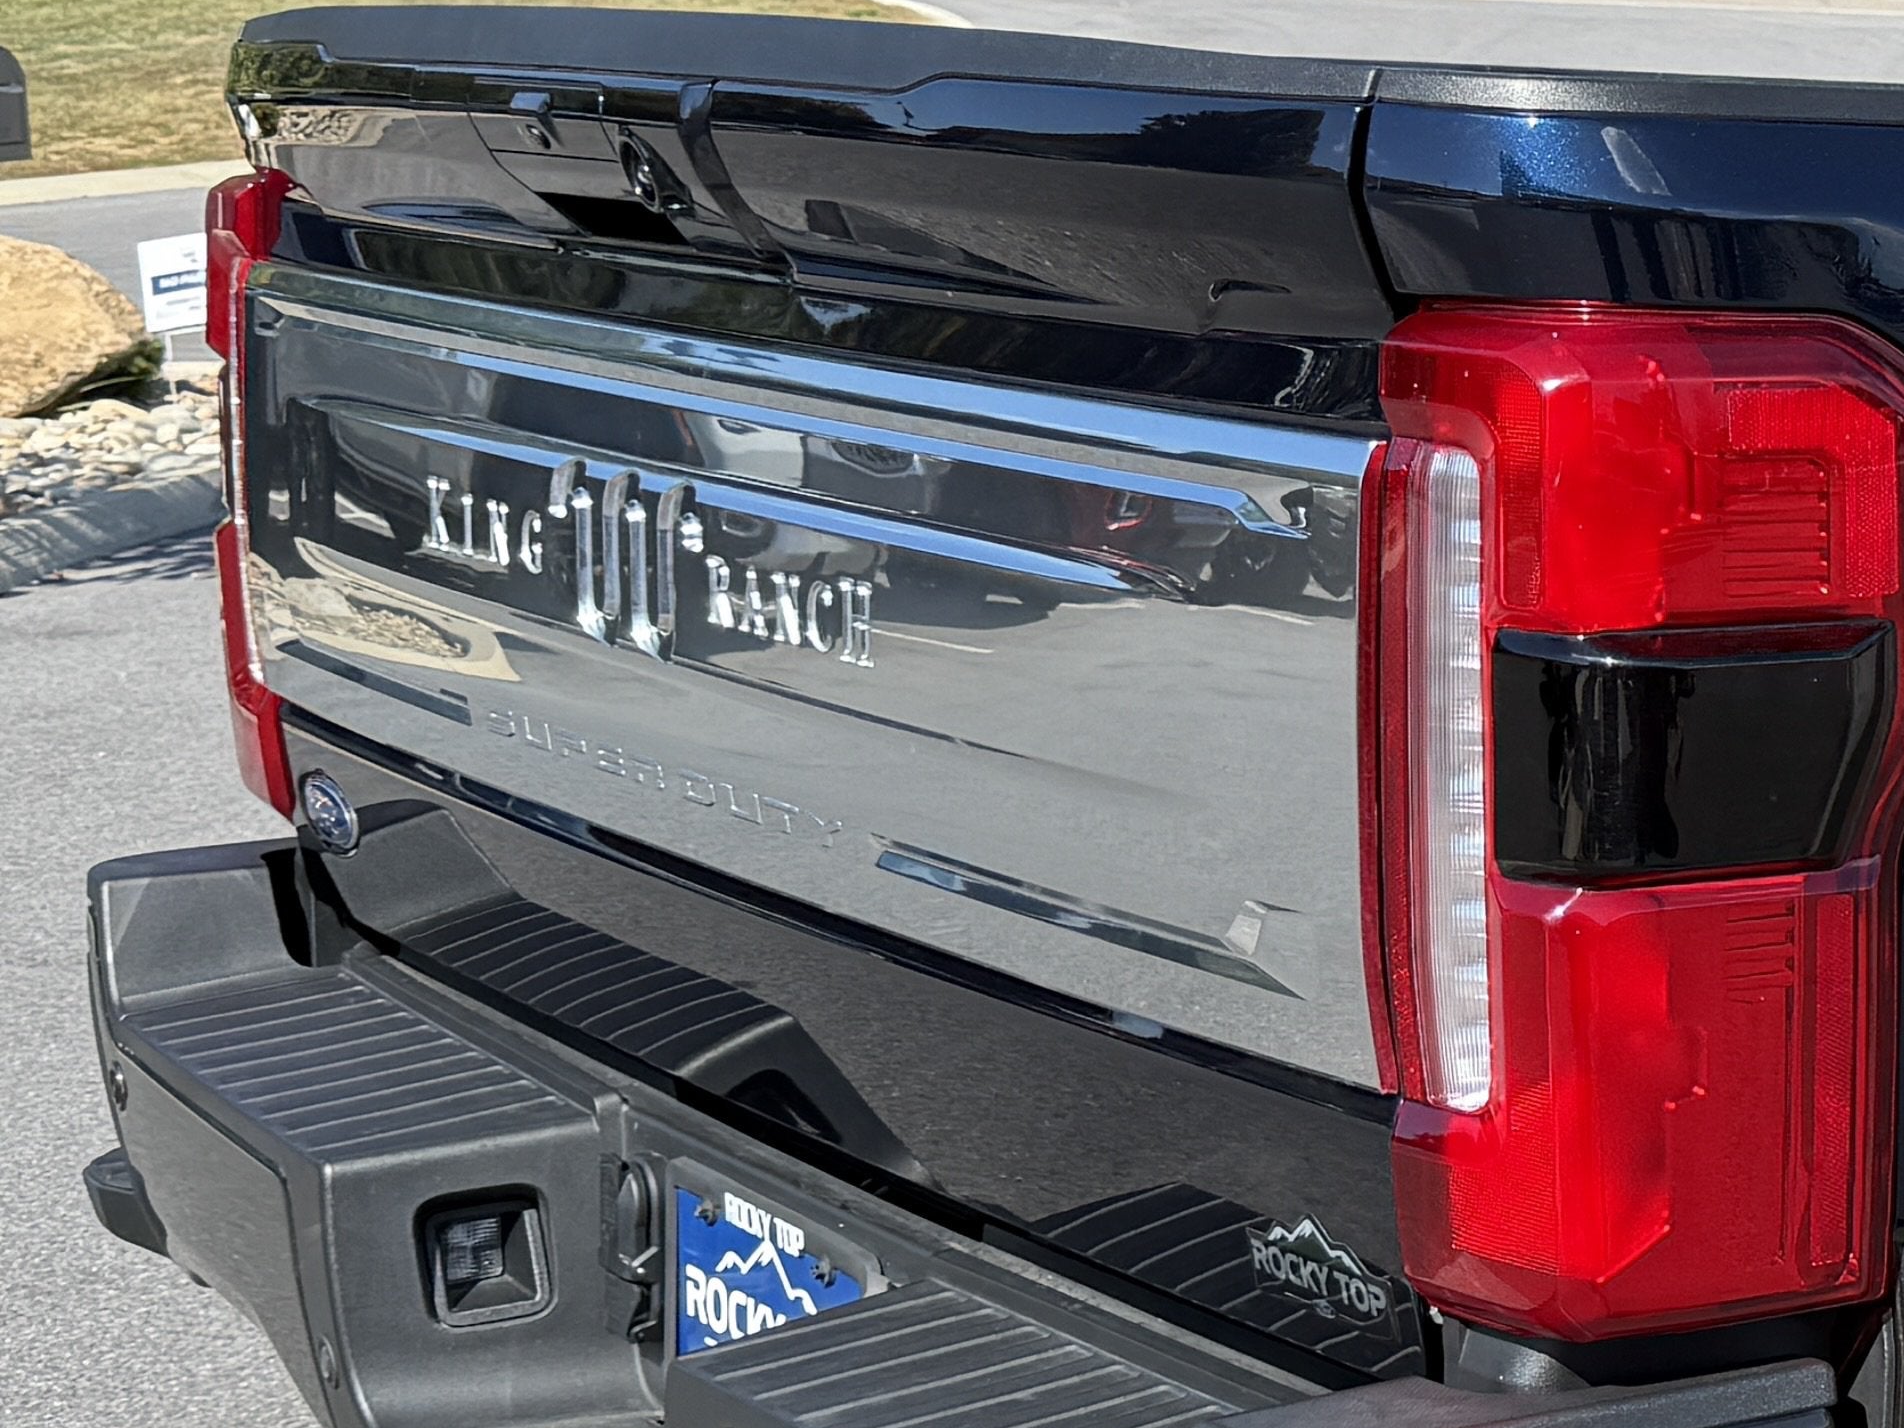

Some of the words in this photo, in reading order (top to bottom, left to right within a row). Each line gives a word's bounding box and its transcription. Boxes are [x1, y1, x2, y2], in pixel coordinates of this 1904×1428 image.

[426, 474, 542, 575] KING
[704, 553, 875, 668] RANCH
[487, 709, 667, 791] SUPER
[678, 767, 843, 849] DUTY
[724, 1191, 774, 1244] ROCKY
[773, 1217, 805, 1258] TOP
[1250, 1236, 1329, 1297] ROCKY
[1332, 1270, 1387, 1318] TOP
